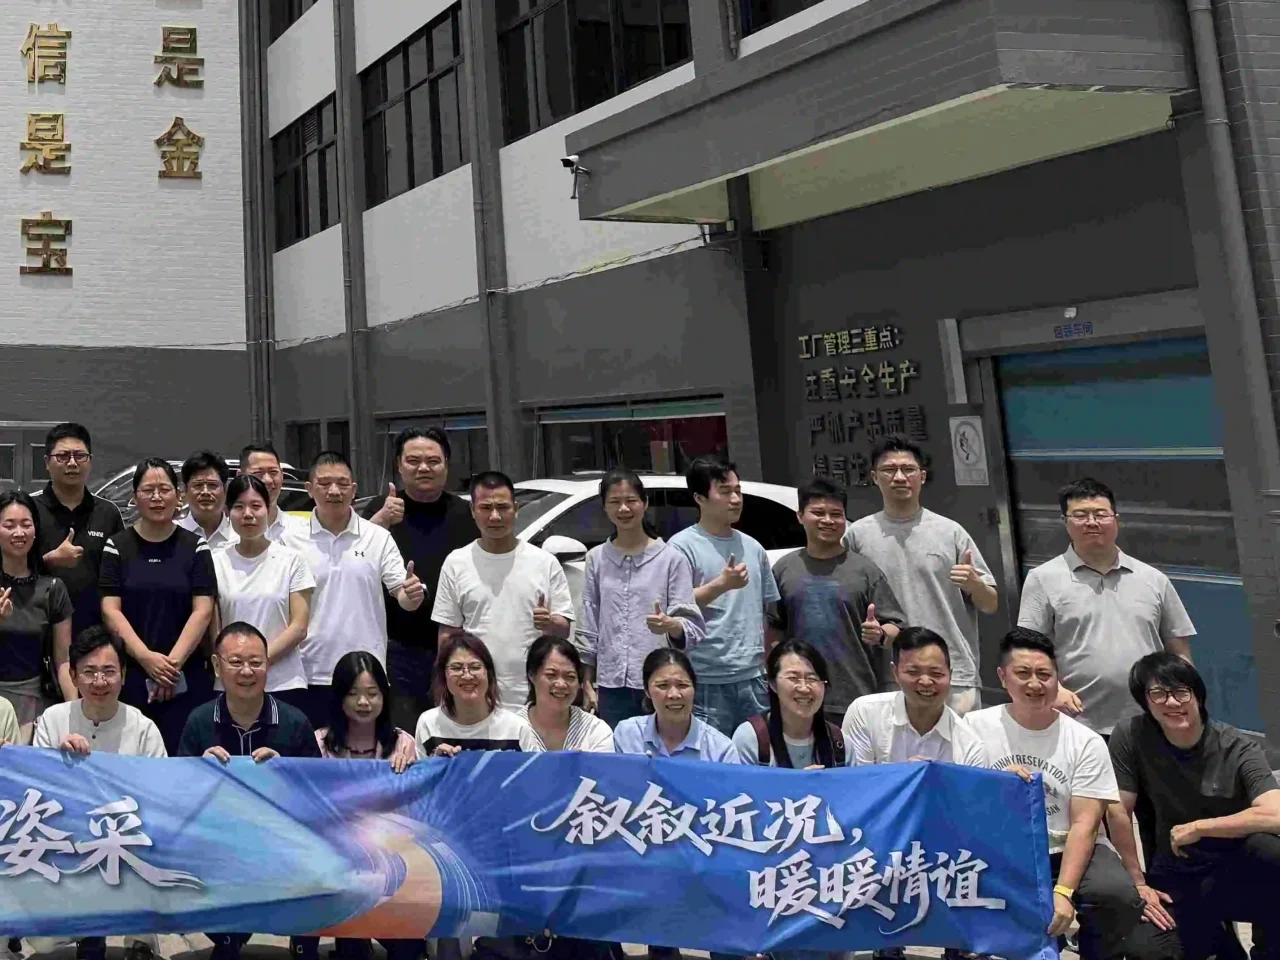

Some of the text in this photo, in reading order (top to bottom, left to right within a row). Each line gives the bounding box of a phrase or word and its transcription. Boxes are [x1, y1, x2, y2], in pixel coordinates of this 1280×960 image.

[805, 360, 918, 401] 注重安全生产
[531, 775, 864, 856] 叙叙近况，
[748, 841, 1006, 935] 暖暖情谊
